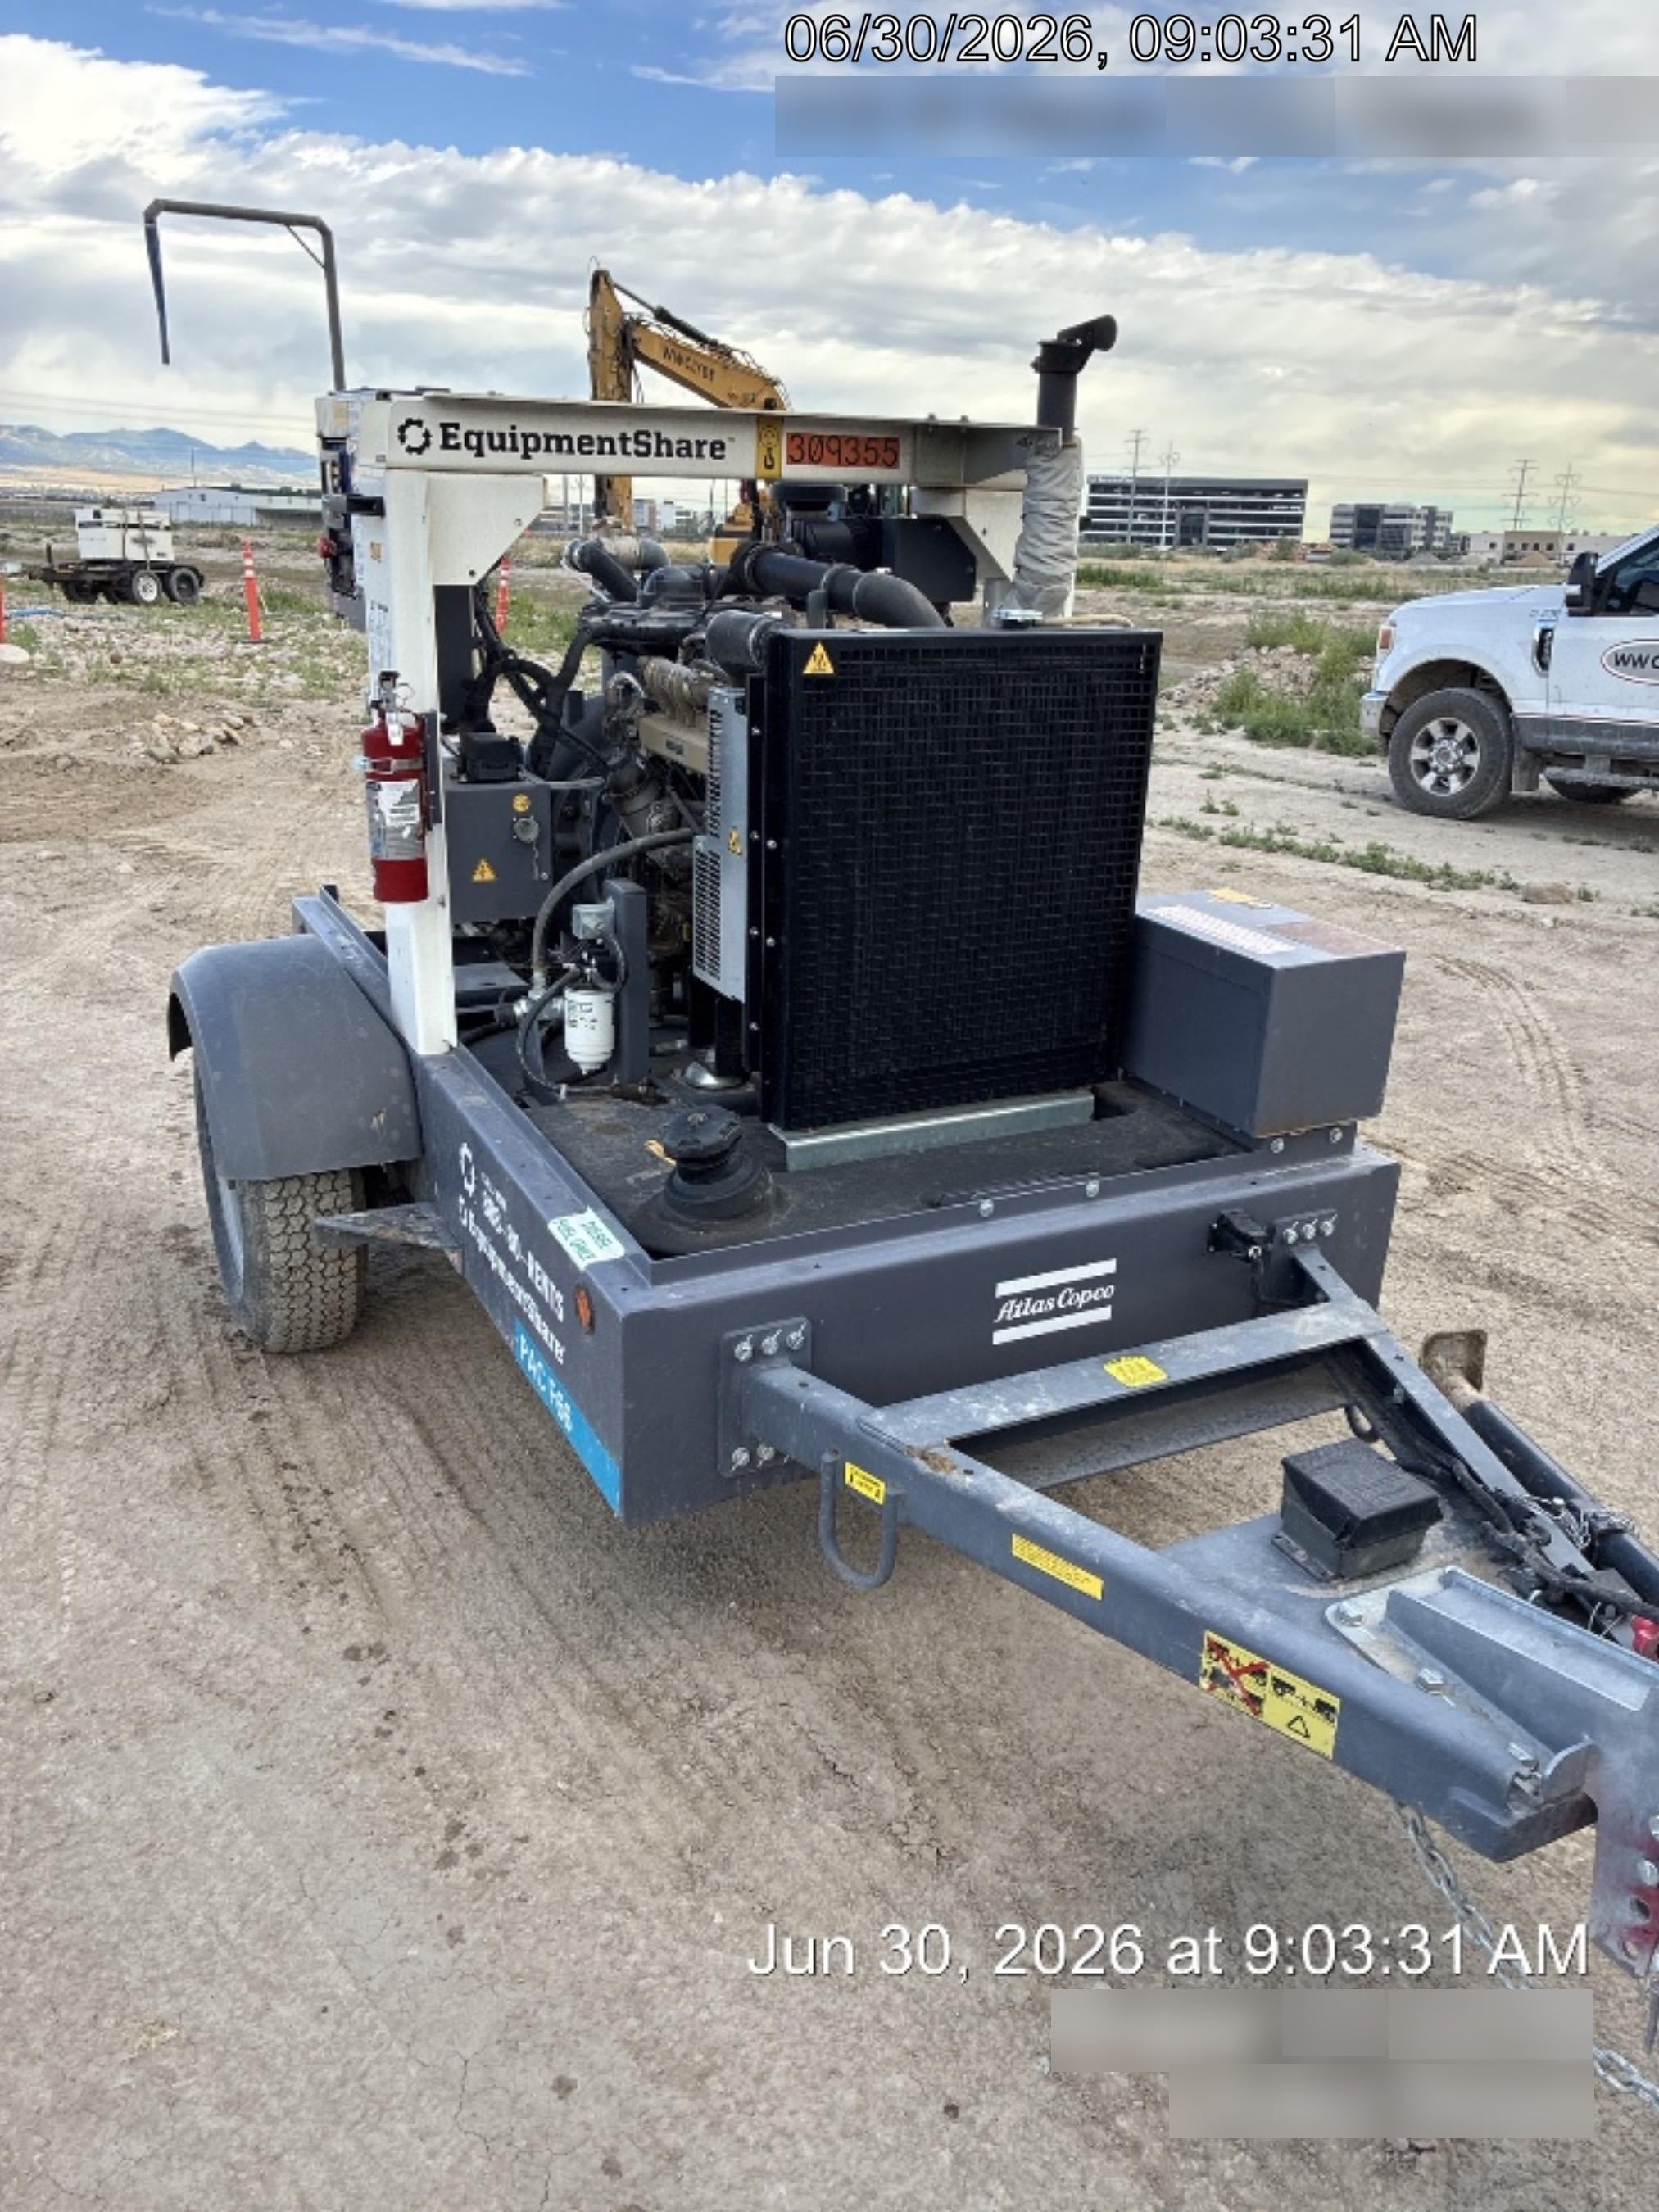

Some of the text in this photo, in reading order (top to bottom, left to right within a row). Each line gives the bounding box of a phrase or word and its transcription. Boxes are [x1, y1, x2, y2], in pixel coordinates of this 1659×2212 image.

[439, 421, 727, 460] EquipmentShare
[788, 433, 899, 468] 309355
[993, 1284, 1115, 1323] Atlas Copco
